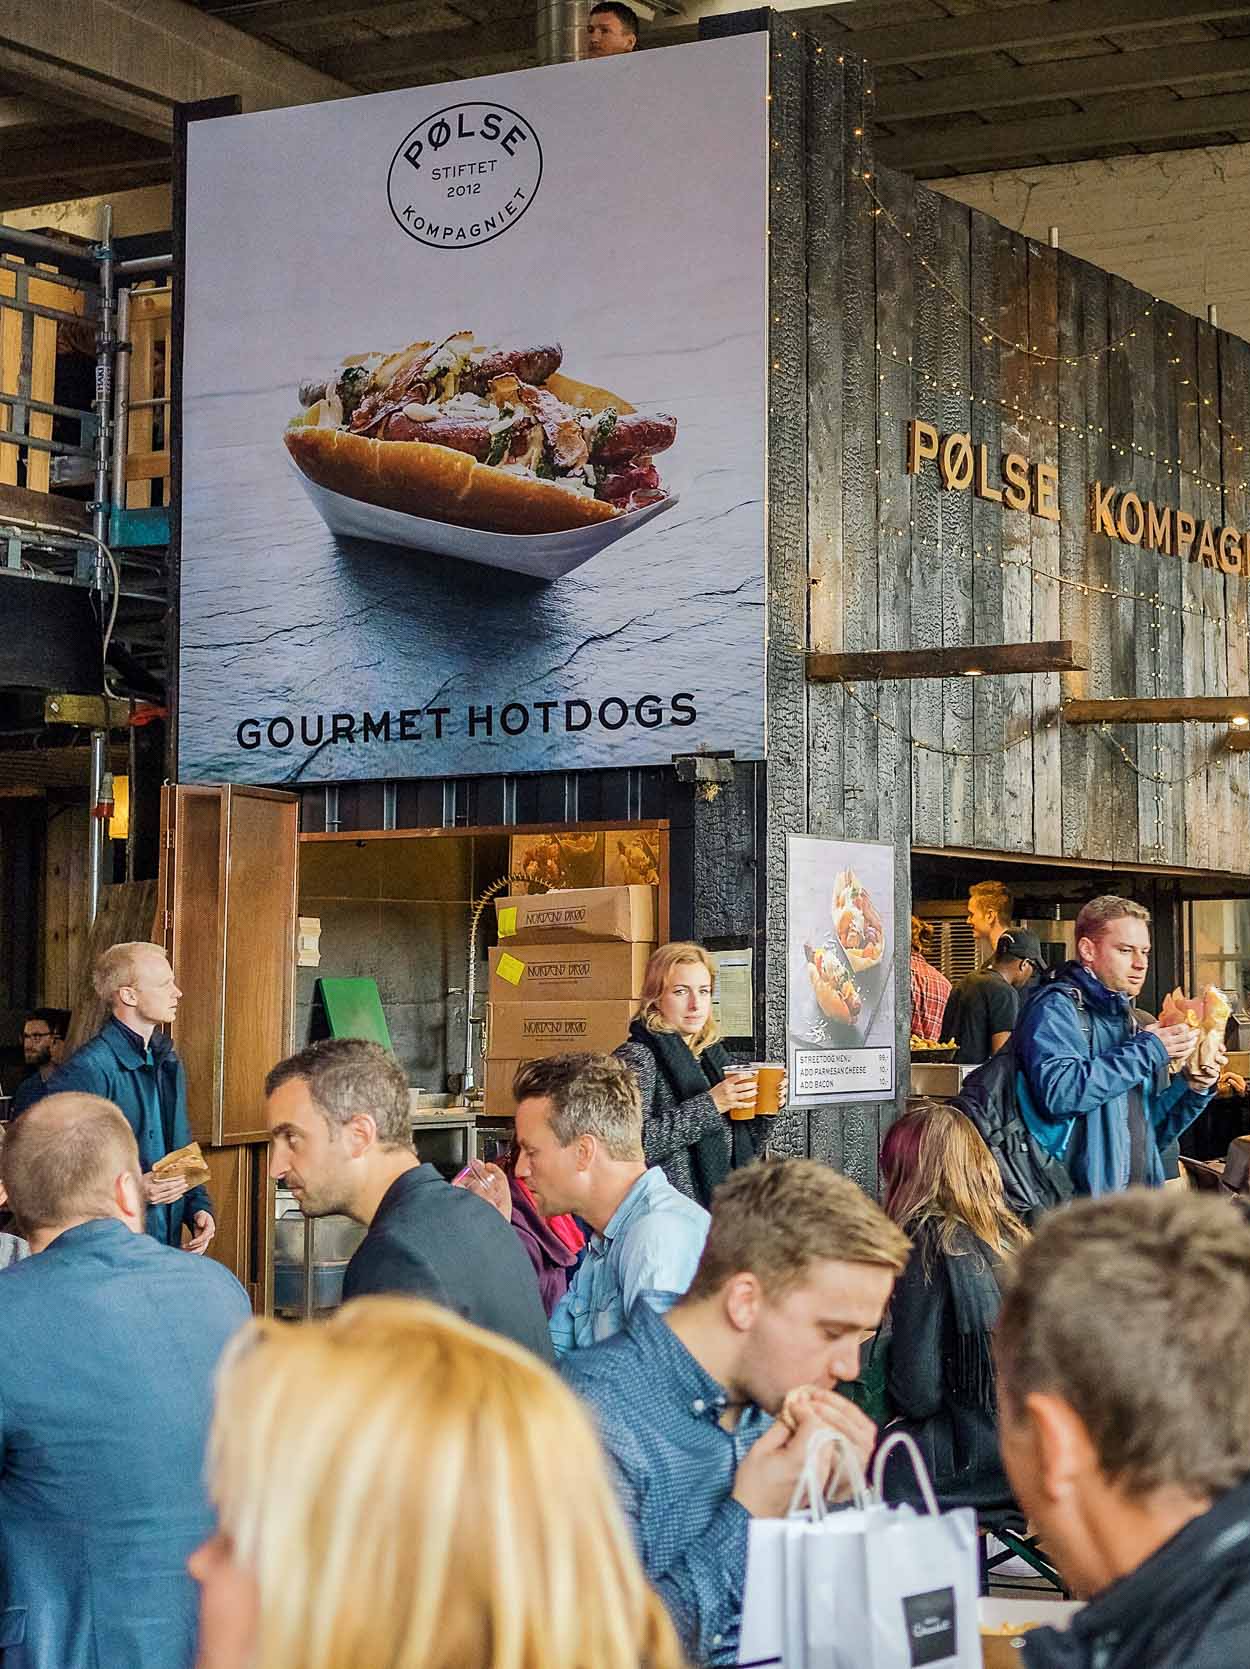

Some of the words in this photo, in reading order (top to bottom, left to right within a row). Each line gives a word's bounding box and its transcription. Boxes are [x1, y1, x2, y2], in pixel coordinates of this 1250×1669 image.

[403, 113, 528, 170] PØLSE
[431, 159, 498, 181] STIFTET
[447, 183, 481, 198] 2012
[402, 187, 526, 240] KOMPAGNIET
[908, 419, 1061, 521] PØLSE
[236, 707, 451, 750] GOURMET
[468, 692, 698, 738] HOTDOGS
